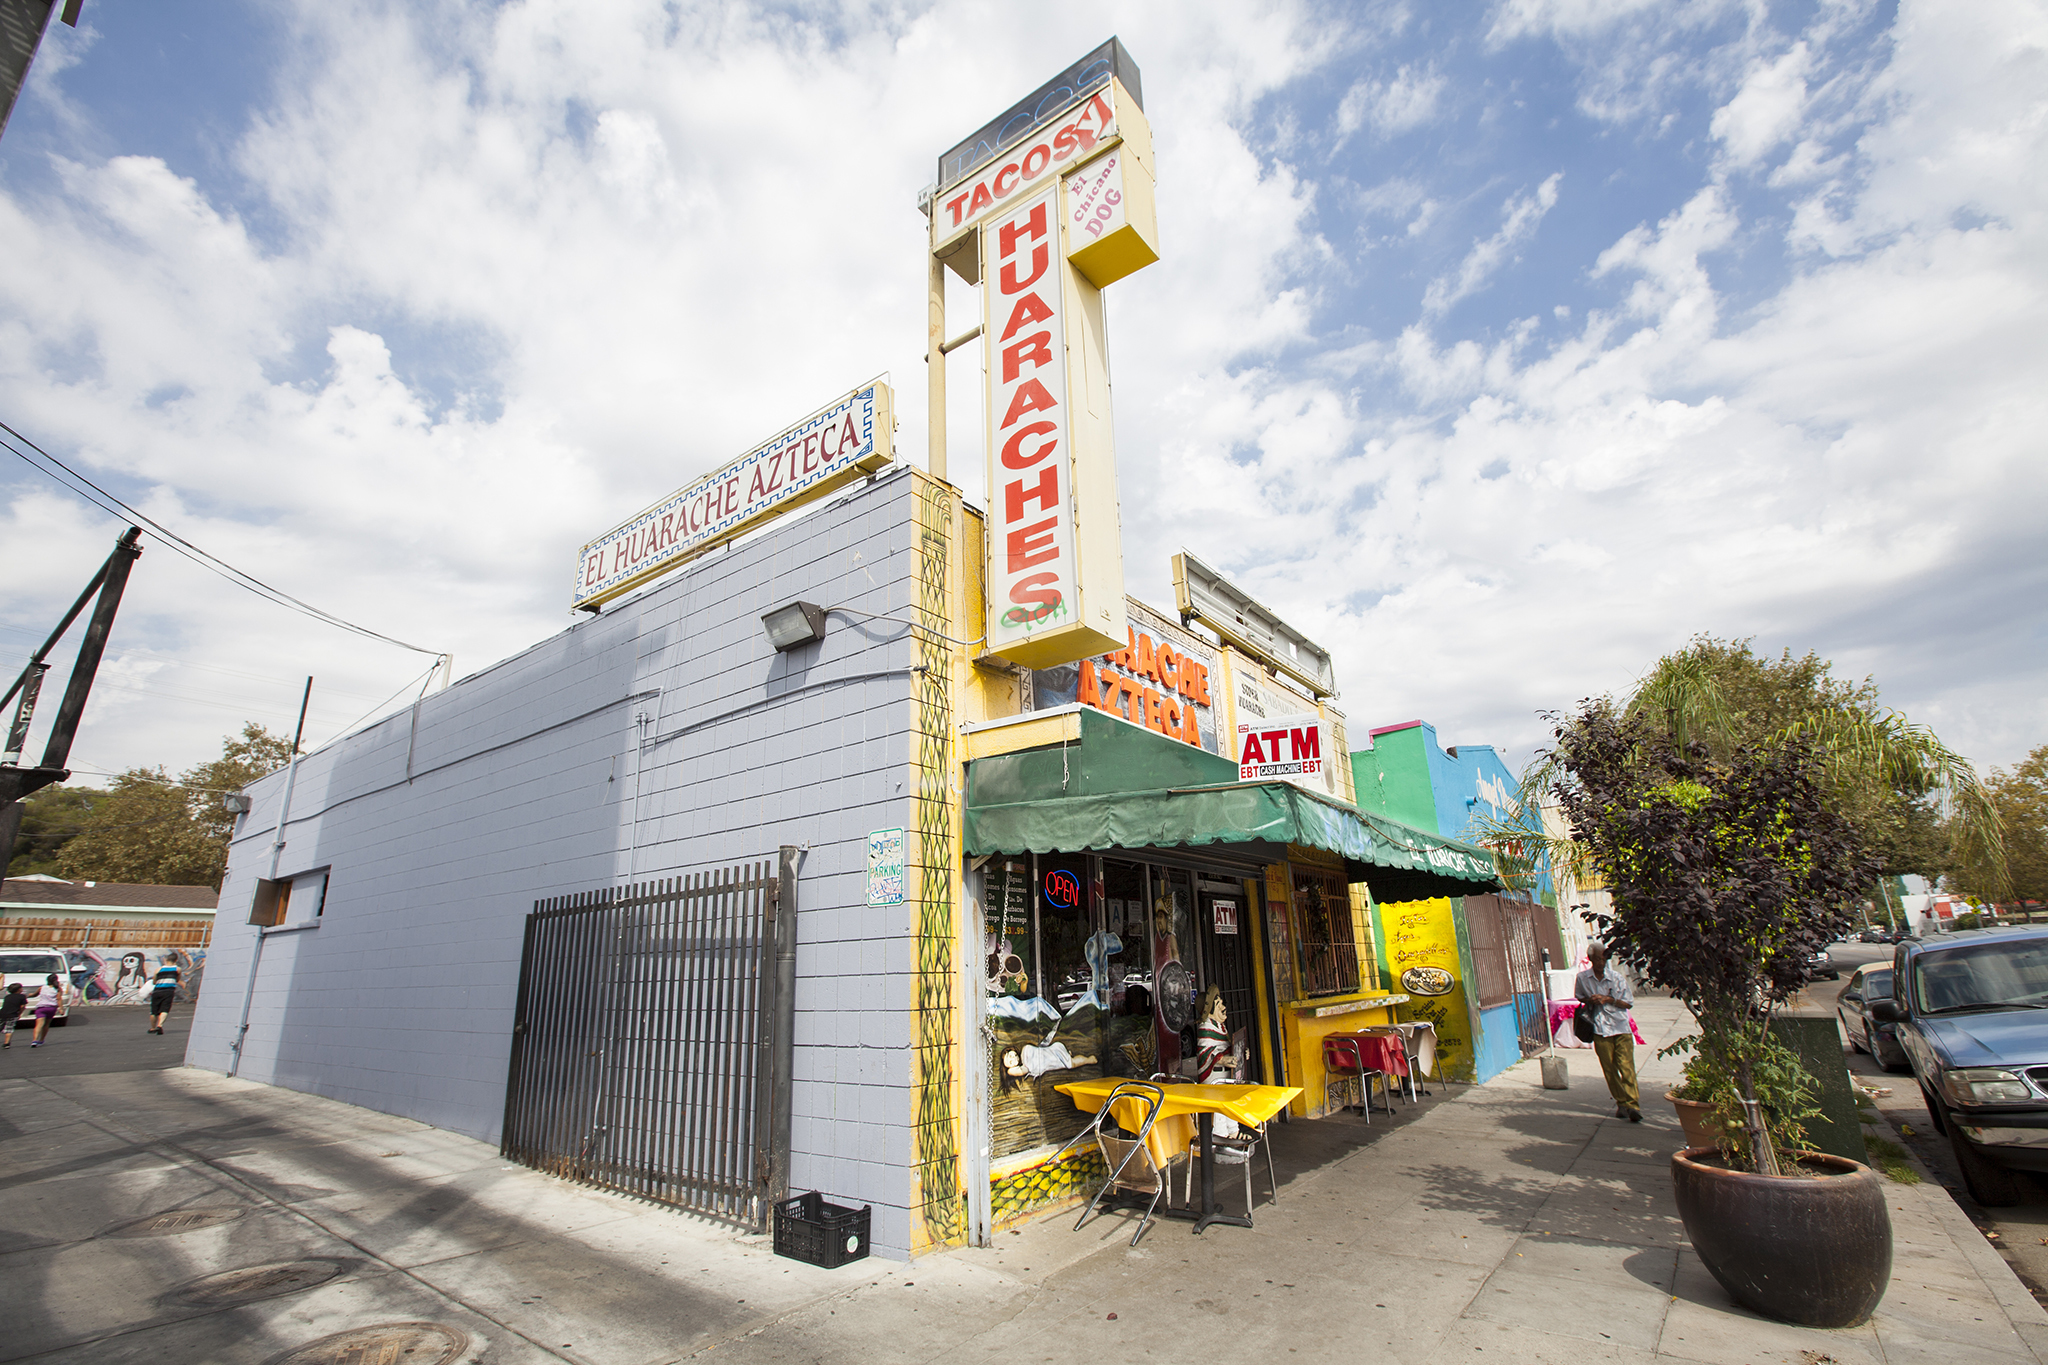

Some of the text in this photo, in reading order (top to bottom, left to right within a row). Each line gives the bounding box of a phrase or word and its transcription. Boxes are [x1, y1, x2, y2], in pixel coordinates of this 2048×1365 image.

[946, 124, 1077, 227] TACOS
[1071, 175, 1087, 197] El
[1073, 157, 1116, 222] Chicano
[1085, 188, 1122, 238] DOG
[999, 202, 1062, 623] HUARACHES
[584, 412, 861, 587] EL HUARACHE AZTECA
[1076, 660, 1201, 748] AZTECA
[1241, 726, 1320, 765] ATM
[1240, 760, 1322, 779] EBT CASH MACHINE EBT
[870, 864, 901, 878] PARKING
[1046, 871, 1078, 906] OPEN
[1112, 905, 1121, 923] A
[1215, 906, 1237, 925] ATM
